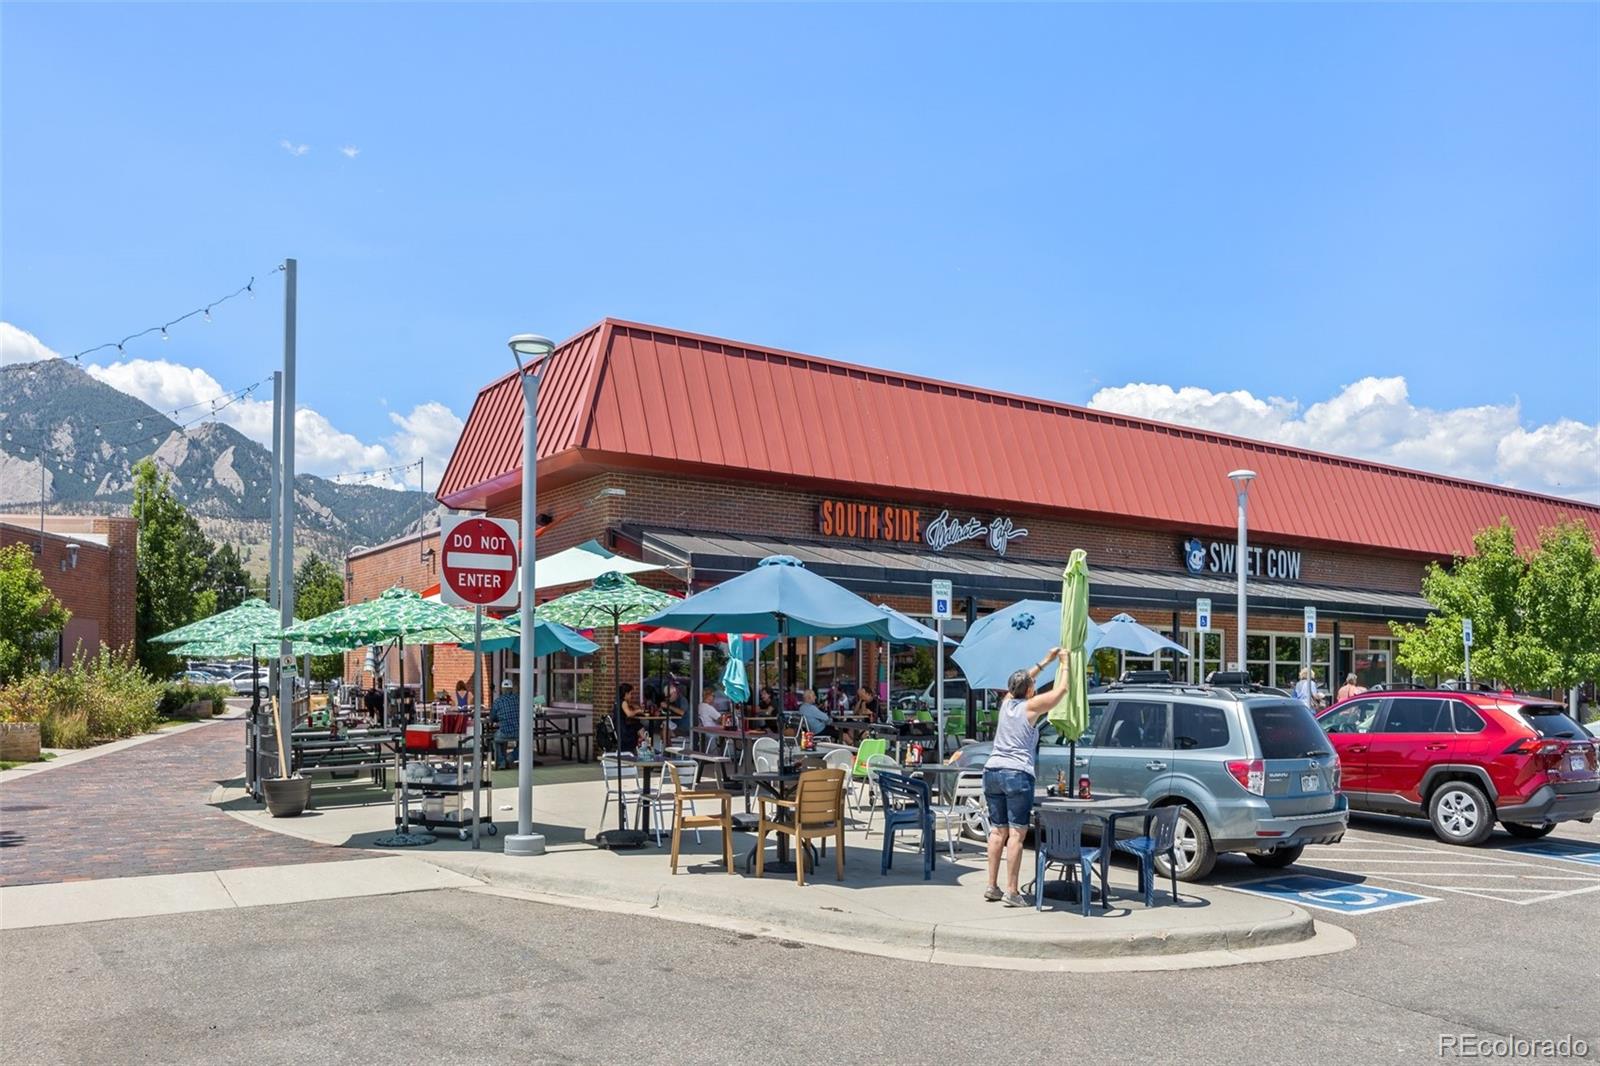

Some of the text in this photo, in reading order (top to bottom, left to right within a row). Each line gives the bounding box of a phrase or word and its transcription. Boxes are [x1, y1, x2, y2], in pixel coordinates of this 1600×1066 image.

[823, 500, 879, 539] SOUTH
[884, 507, 920, 543] SIDE
[926, 510, 988, 551] Walnut
[454, 534, 506, 550] DO NOT
[1267, 549, 1301, 580] COW
[458, 573, 501, 588] ENTER
